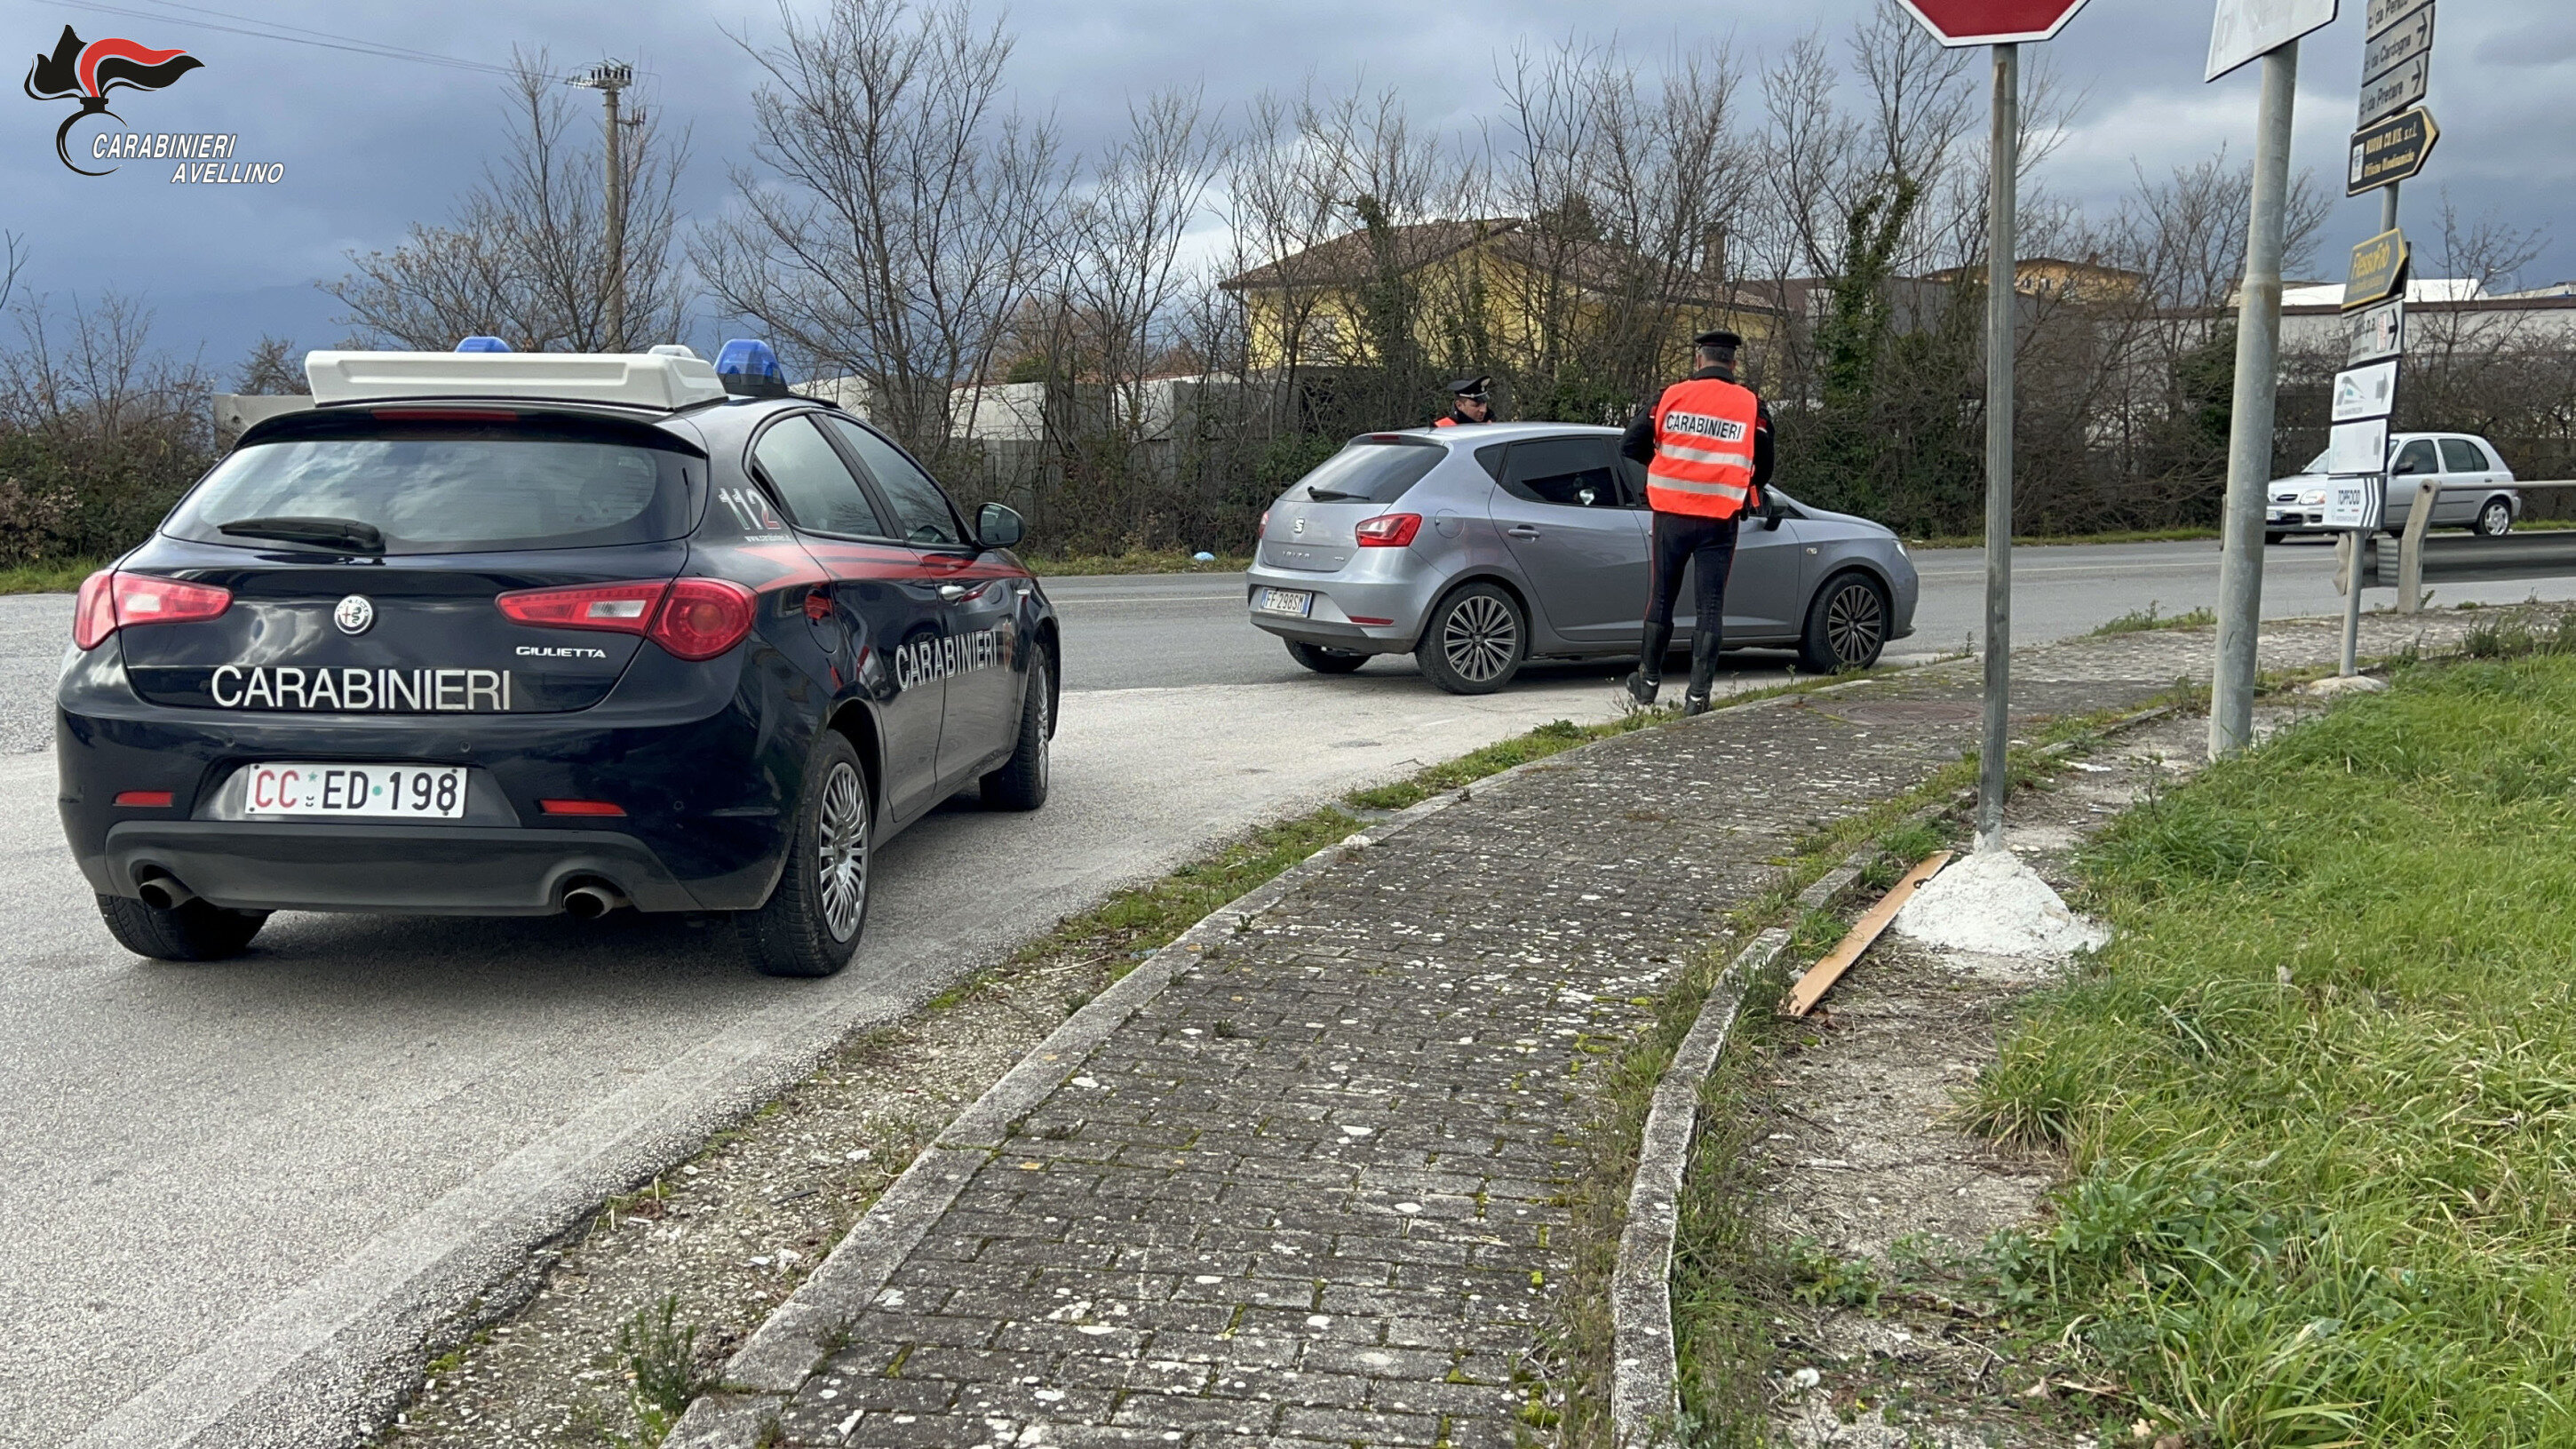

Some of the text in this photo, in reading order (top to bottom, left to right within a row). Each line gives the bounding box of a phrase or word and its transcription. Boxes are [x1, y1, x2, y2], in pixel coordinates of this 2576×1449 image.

[1666, 414, 1742, 440] CARABINIERI
[718, 488, 781, 530] 112
[1265, 592, 1277, 608] FF
[515, 646, 607, 658] GIULIETTA
[895, 630, 997, 692] CARABINIERI
[211, 665, 511, 711] CARABINIERI
[255, 769, 458, 812] CC ED 198
